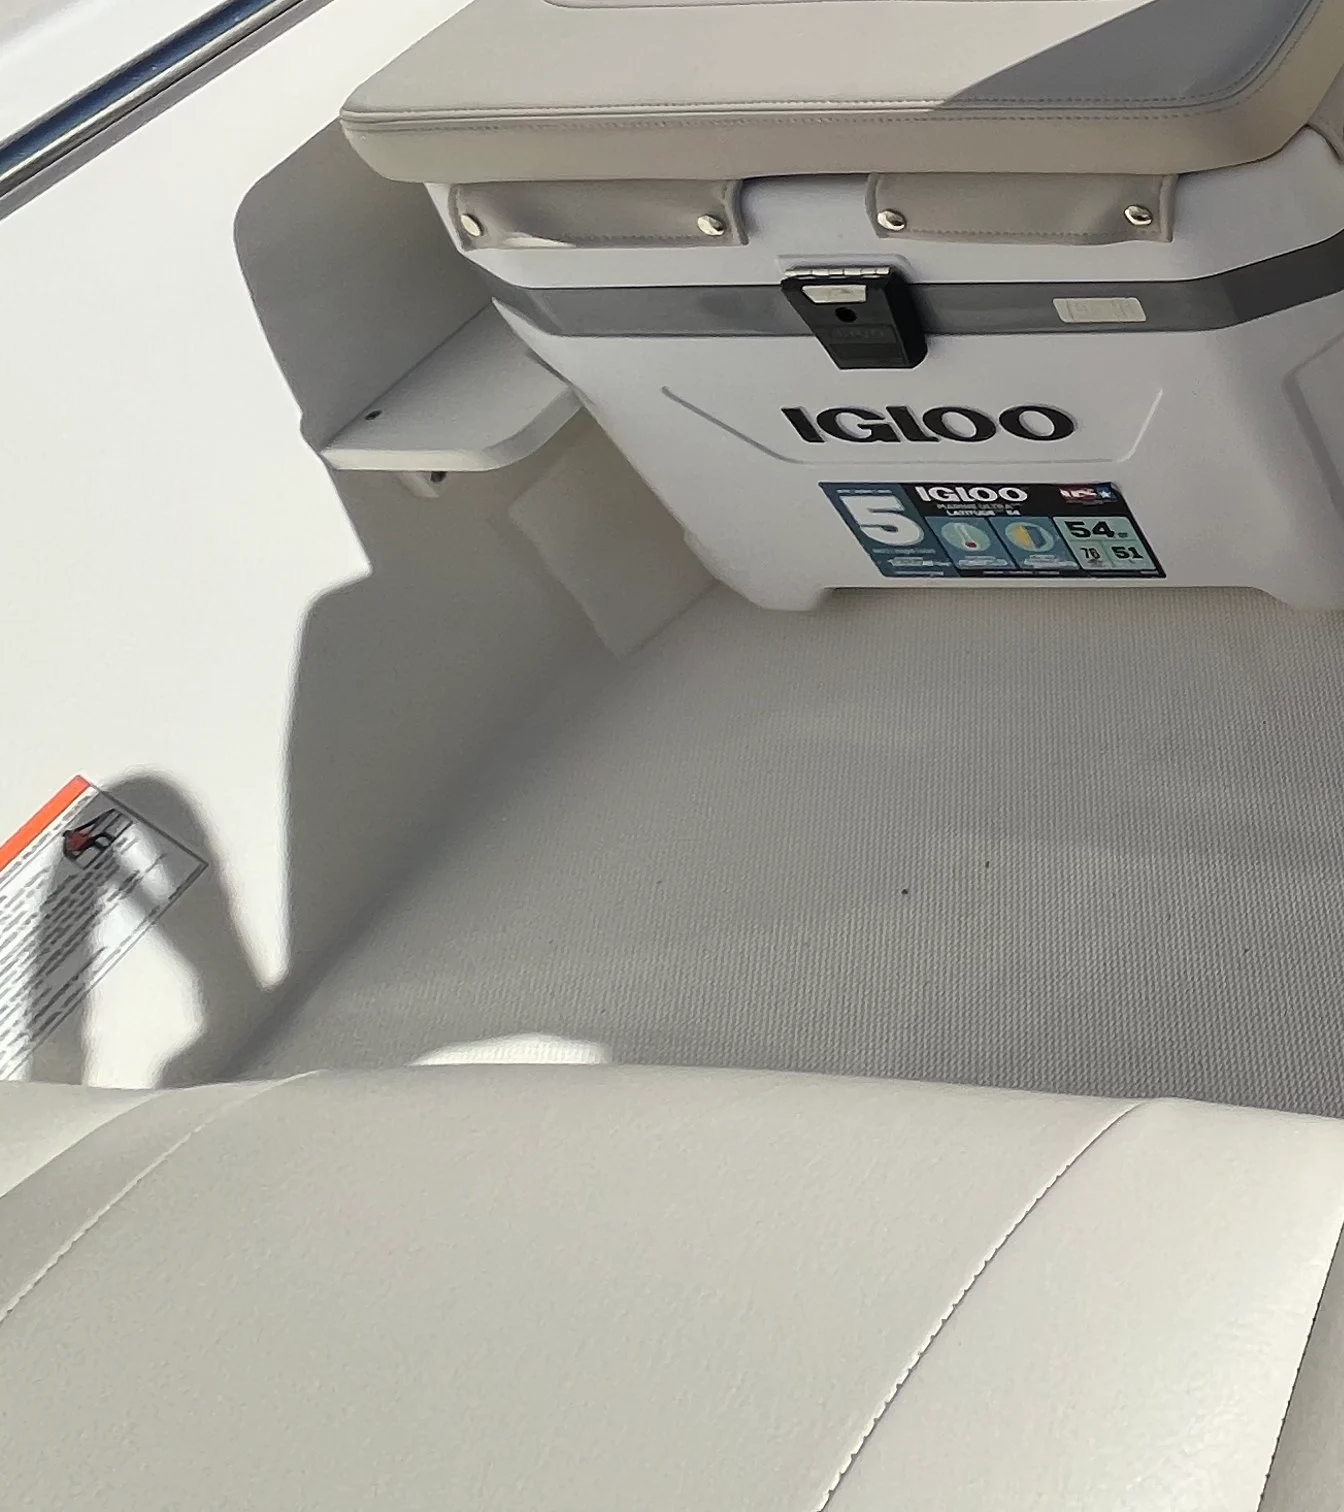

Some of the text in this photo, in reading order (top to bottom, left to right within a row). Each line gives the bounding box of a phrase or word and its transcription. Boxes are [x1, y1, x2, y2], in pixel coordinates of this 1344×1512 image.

[781, 405, 1076, 443] IGLOO
[914, 485, 1028, 503] IGLOO
[839, 495, 925, 546] 5
[1064, 521, 1115, 538] 54
[1111, 546, 1144, 559] 51
